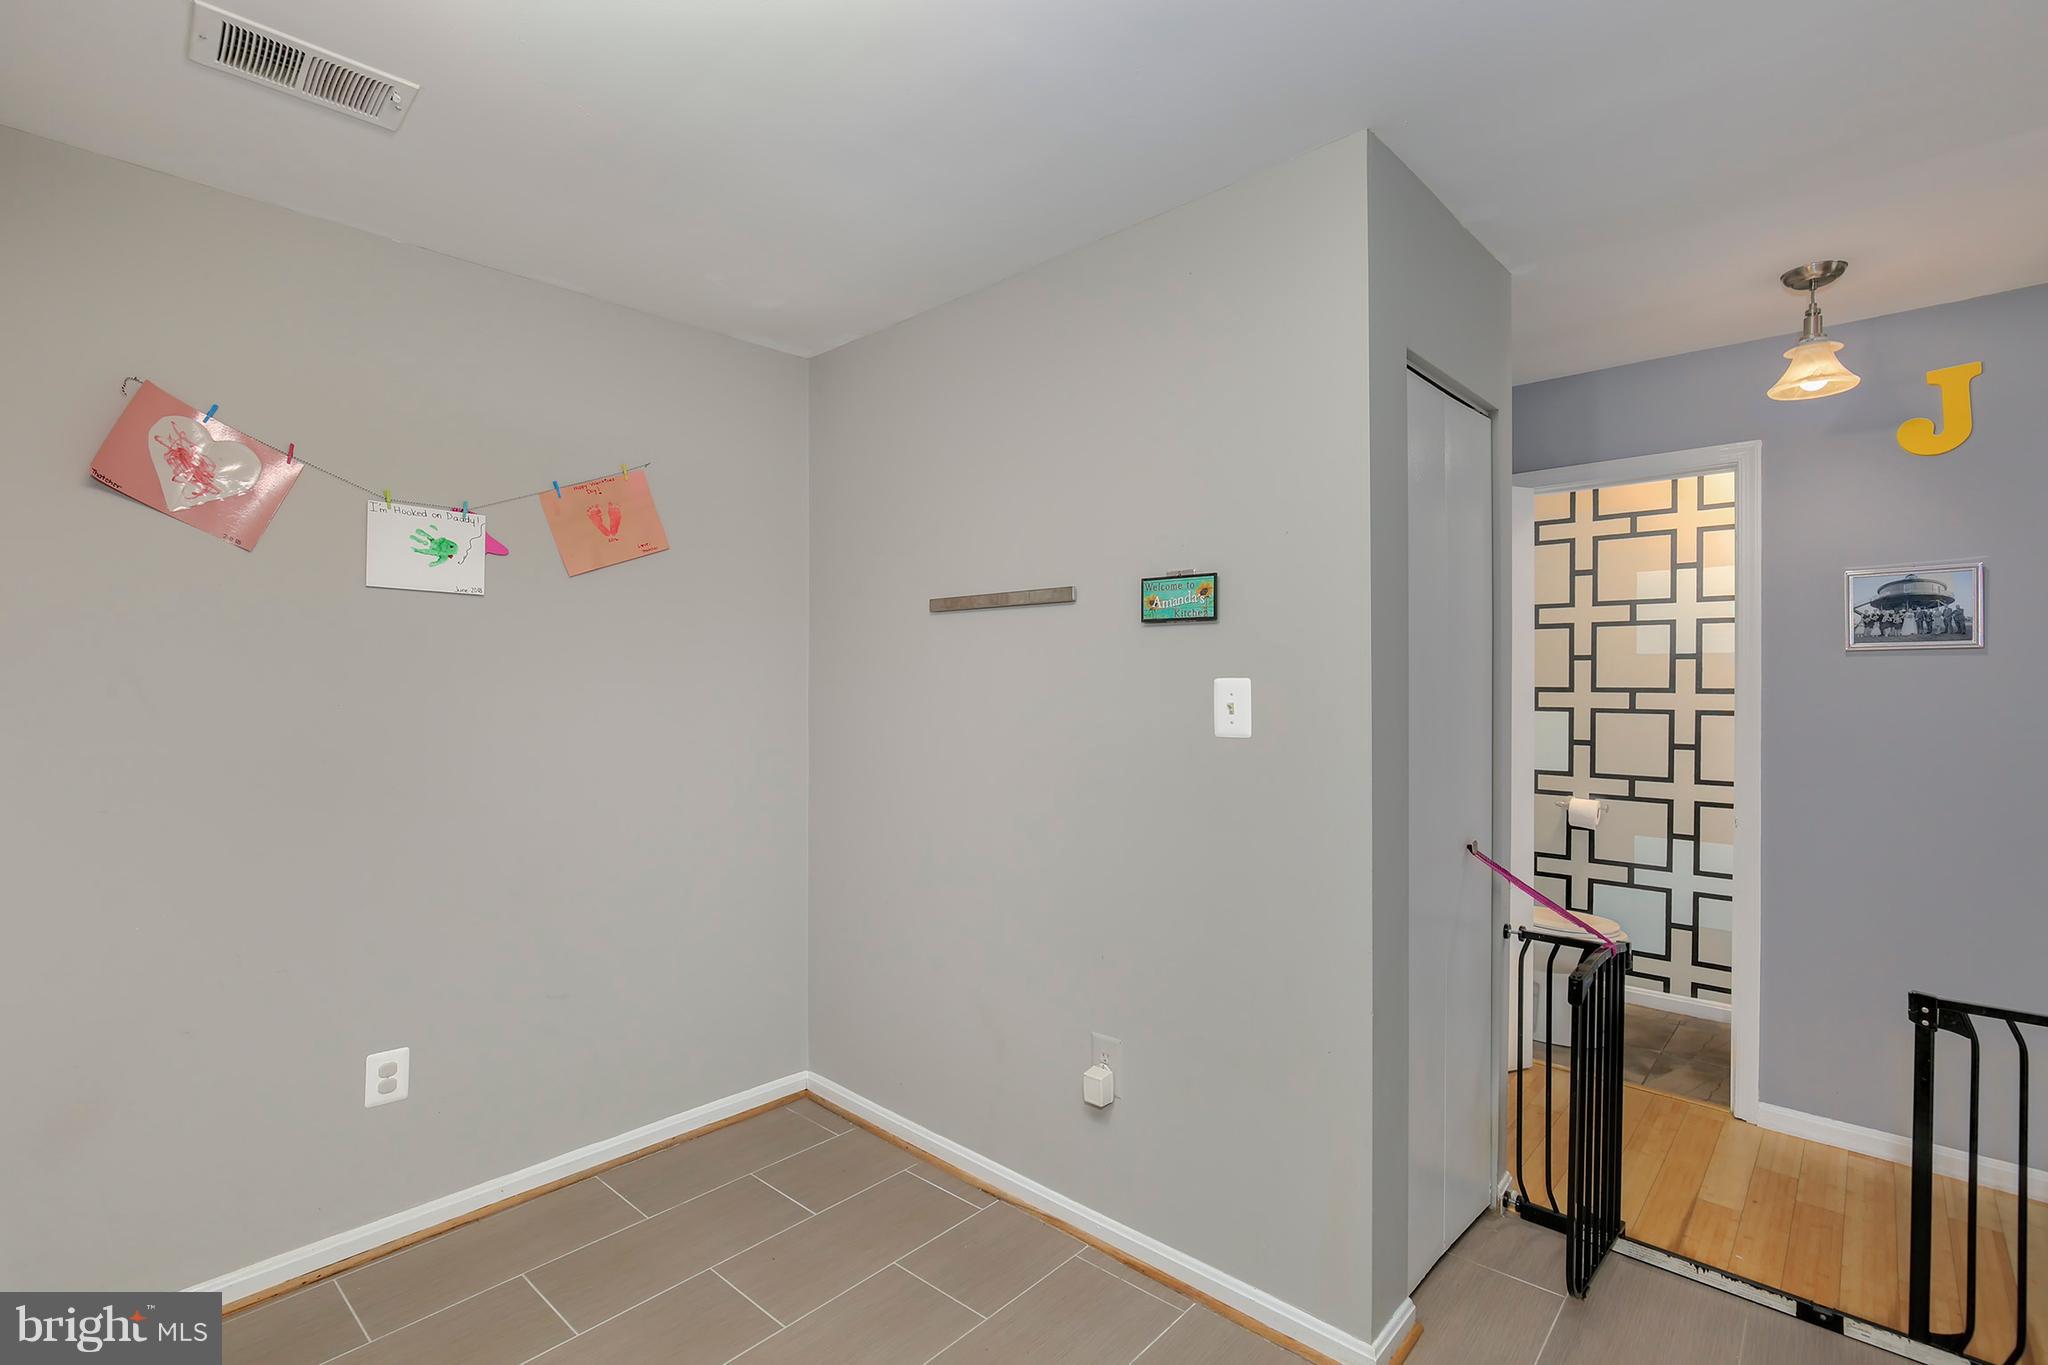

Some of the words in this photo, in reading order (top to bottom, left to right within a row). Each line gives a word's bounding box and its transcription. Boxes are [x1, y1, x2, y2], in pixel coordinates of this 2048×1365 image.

[1896, 361, 1984, 456] J
[393, 506, 428, 518] Hooked
[1144, 582, 1183, 592] Welcome
[1186, 581, 1195, 590] to
[1152, 590, 1206, 609] Amanda's
